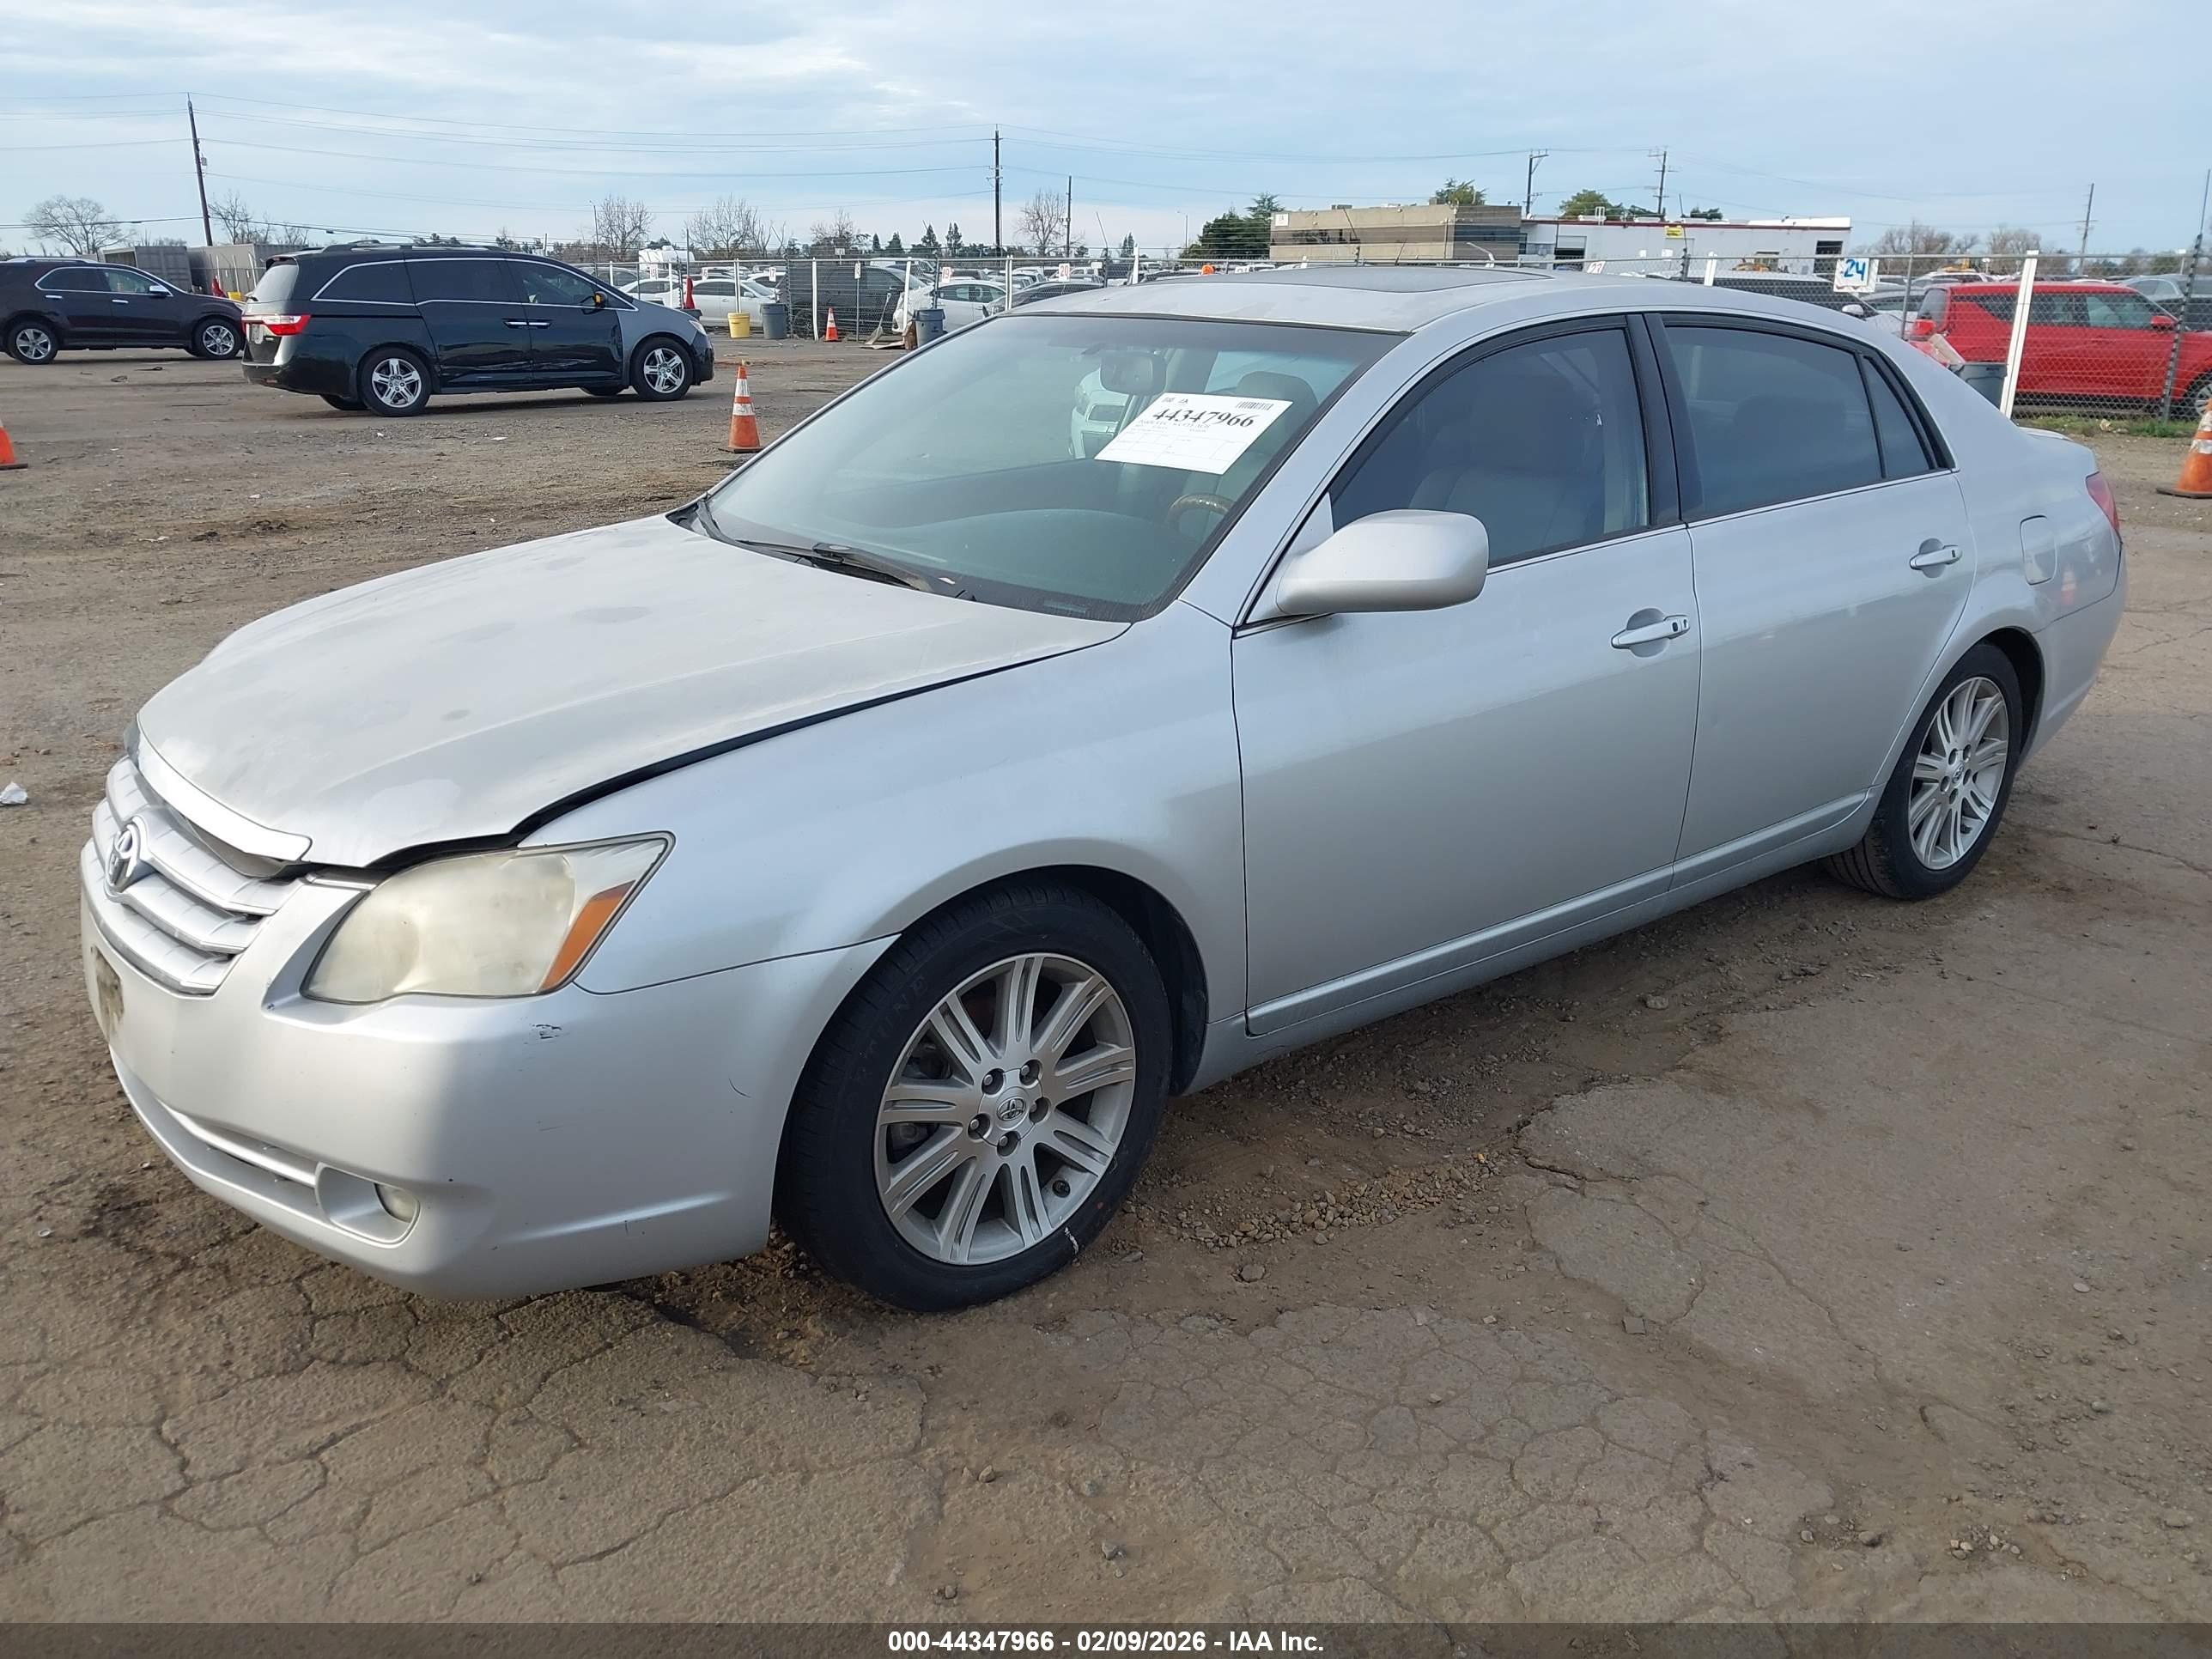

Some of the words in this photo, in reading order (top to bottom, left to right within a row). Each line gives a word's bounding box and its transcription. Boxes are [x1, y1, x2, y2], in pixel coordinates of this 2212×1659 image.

[1060, 265, 1069, 277] 20
[1844, 258, 1866, 281] 24
[1152, 408, 1261, 428] 44347966
